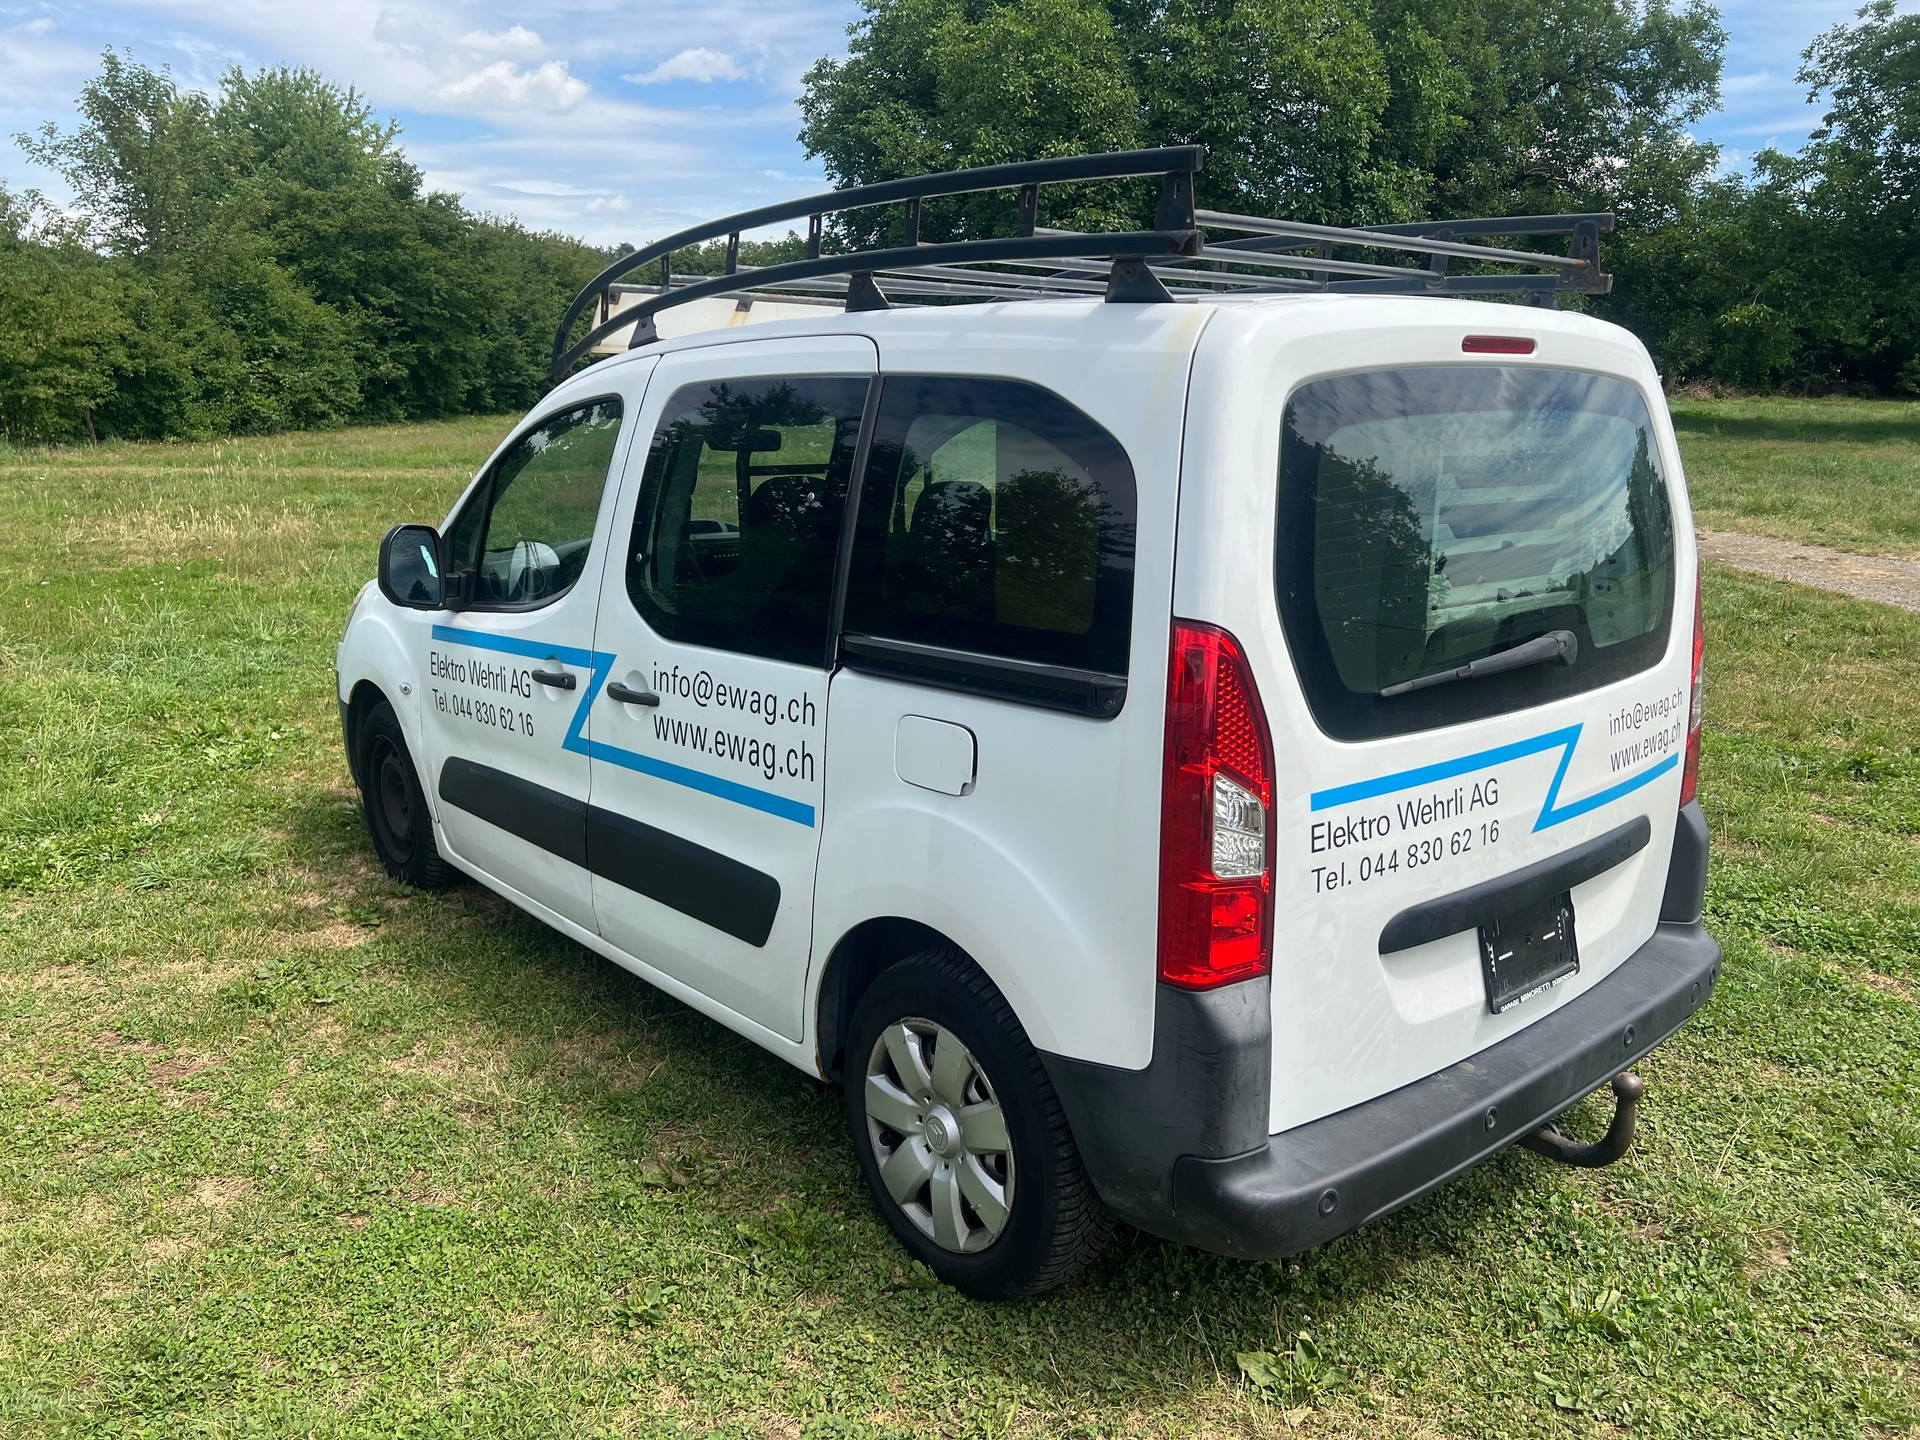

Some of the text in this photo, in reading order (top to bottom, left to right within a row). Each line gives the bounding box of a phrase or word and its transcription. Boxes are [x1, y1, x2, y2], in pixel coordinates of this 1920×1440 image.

[430, 651, 531, 699] Elektro Wehrli AG
[653, 661, 816, 727] info@ewag.ch
[432, 688, 534, 737] Tel. 044 830 62 16
[1608, 686, 1683, 736] info@ewag.ch
[653, 714, 815, 782] www.ewag.ch
[1610, 716, 1681, 772] www.ewag.ch
[1310, 777, 1499, 854] Elektro Wehrli AG
[1311, 819, 1500, 893] Tel. 044 830 62 16
[1500, 998, 1520, 1013] GARAGE
[1520, 981, 1551, 1003] MINORETTI
